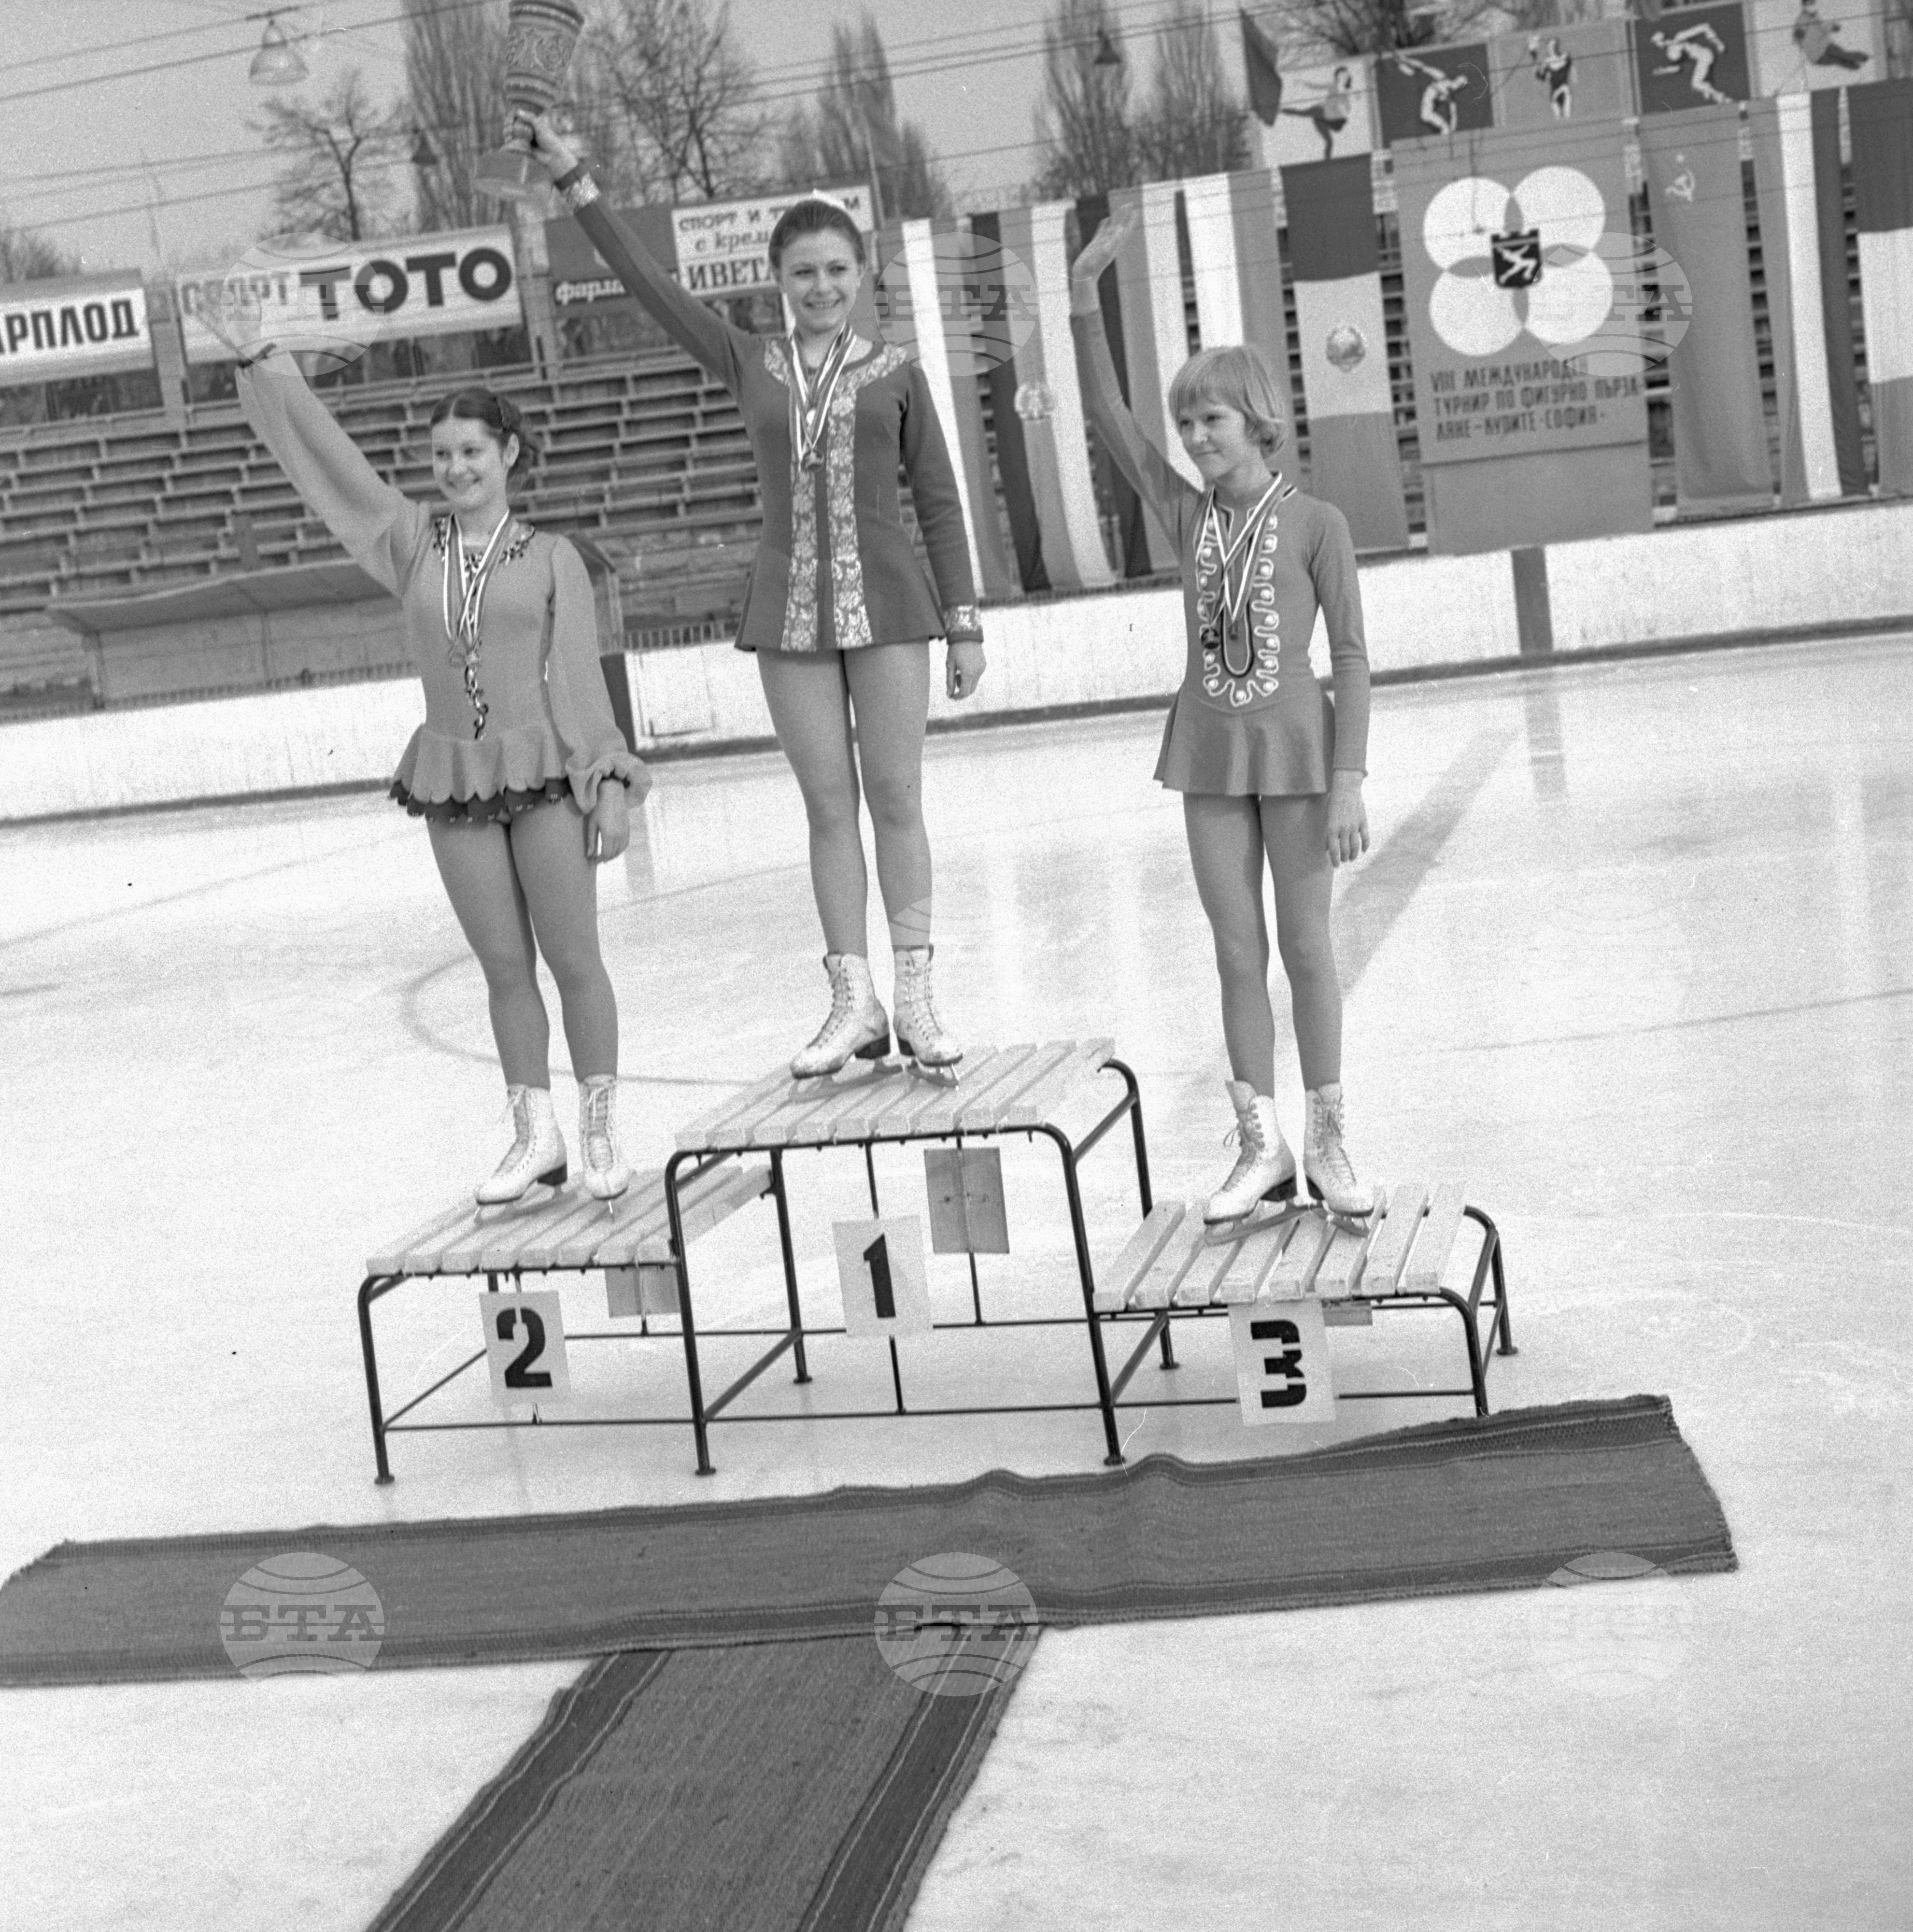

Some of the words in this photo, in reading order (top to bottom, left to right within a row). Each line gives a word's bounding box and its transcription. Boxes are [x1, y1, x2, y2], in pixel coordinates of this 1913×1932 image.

[679, 211, 737, 234] СПОРТ
[748, 208, 761, 224] И
[298, 246, 512, 321] ТОТО
[686, 256, 774, 289] ИВЕТ
[0, 298, 140, 355] РПЛОД
[1434, 391, 1490, 416] ТУРНИР
[1495, 389, 1515, 410] ПО
[863, 1233, 896, 1319] 1
[496, 1307, 553, 1388] 2
[1250, 1319, 1307, 1408] 3
